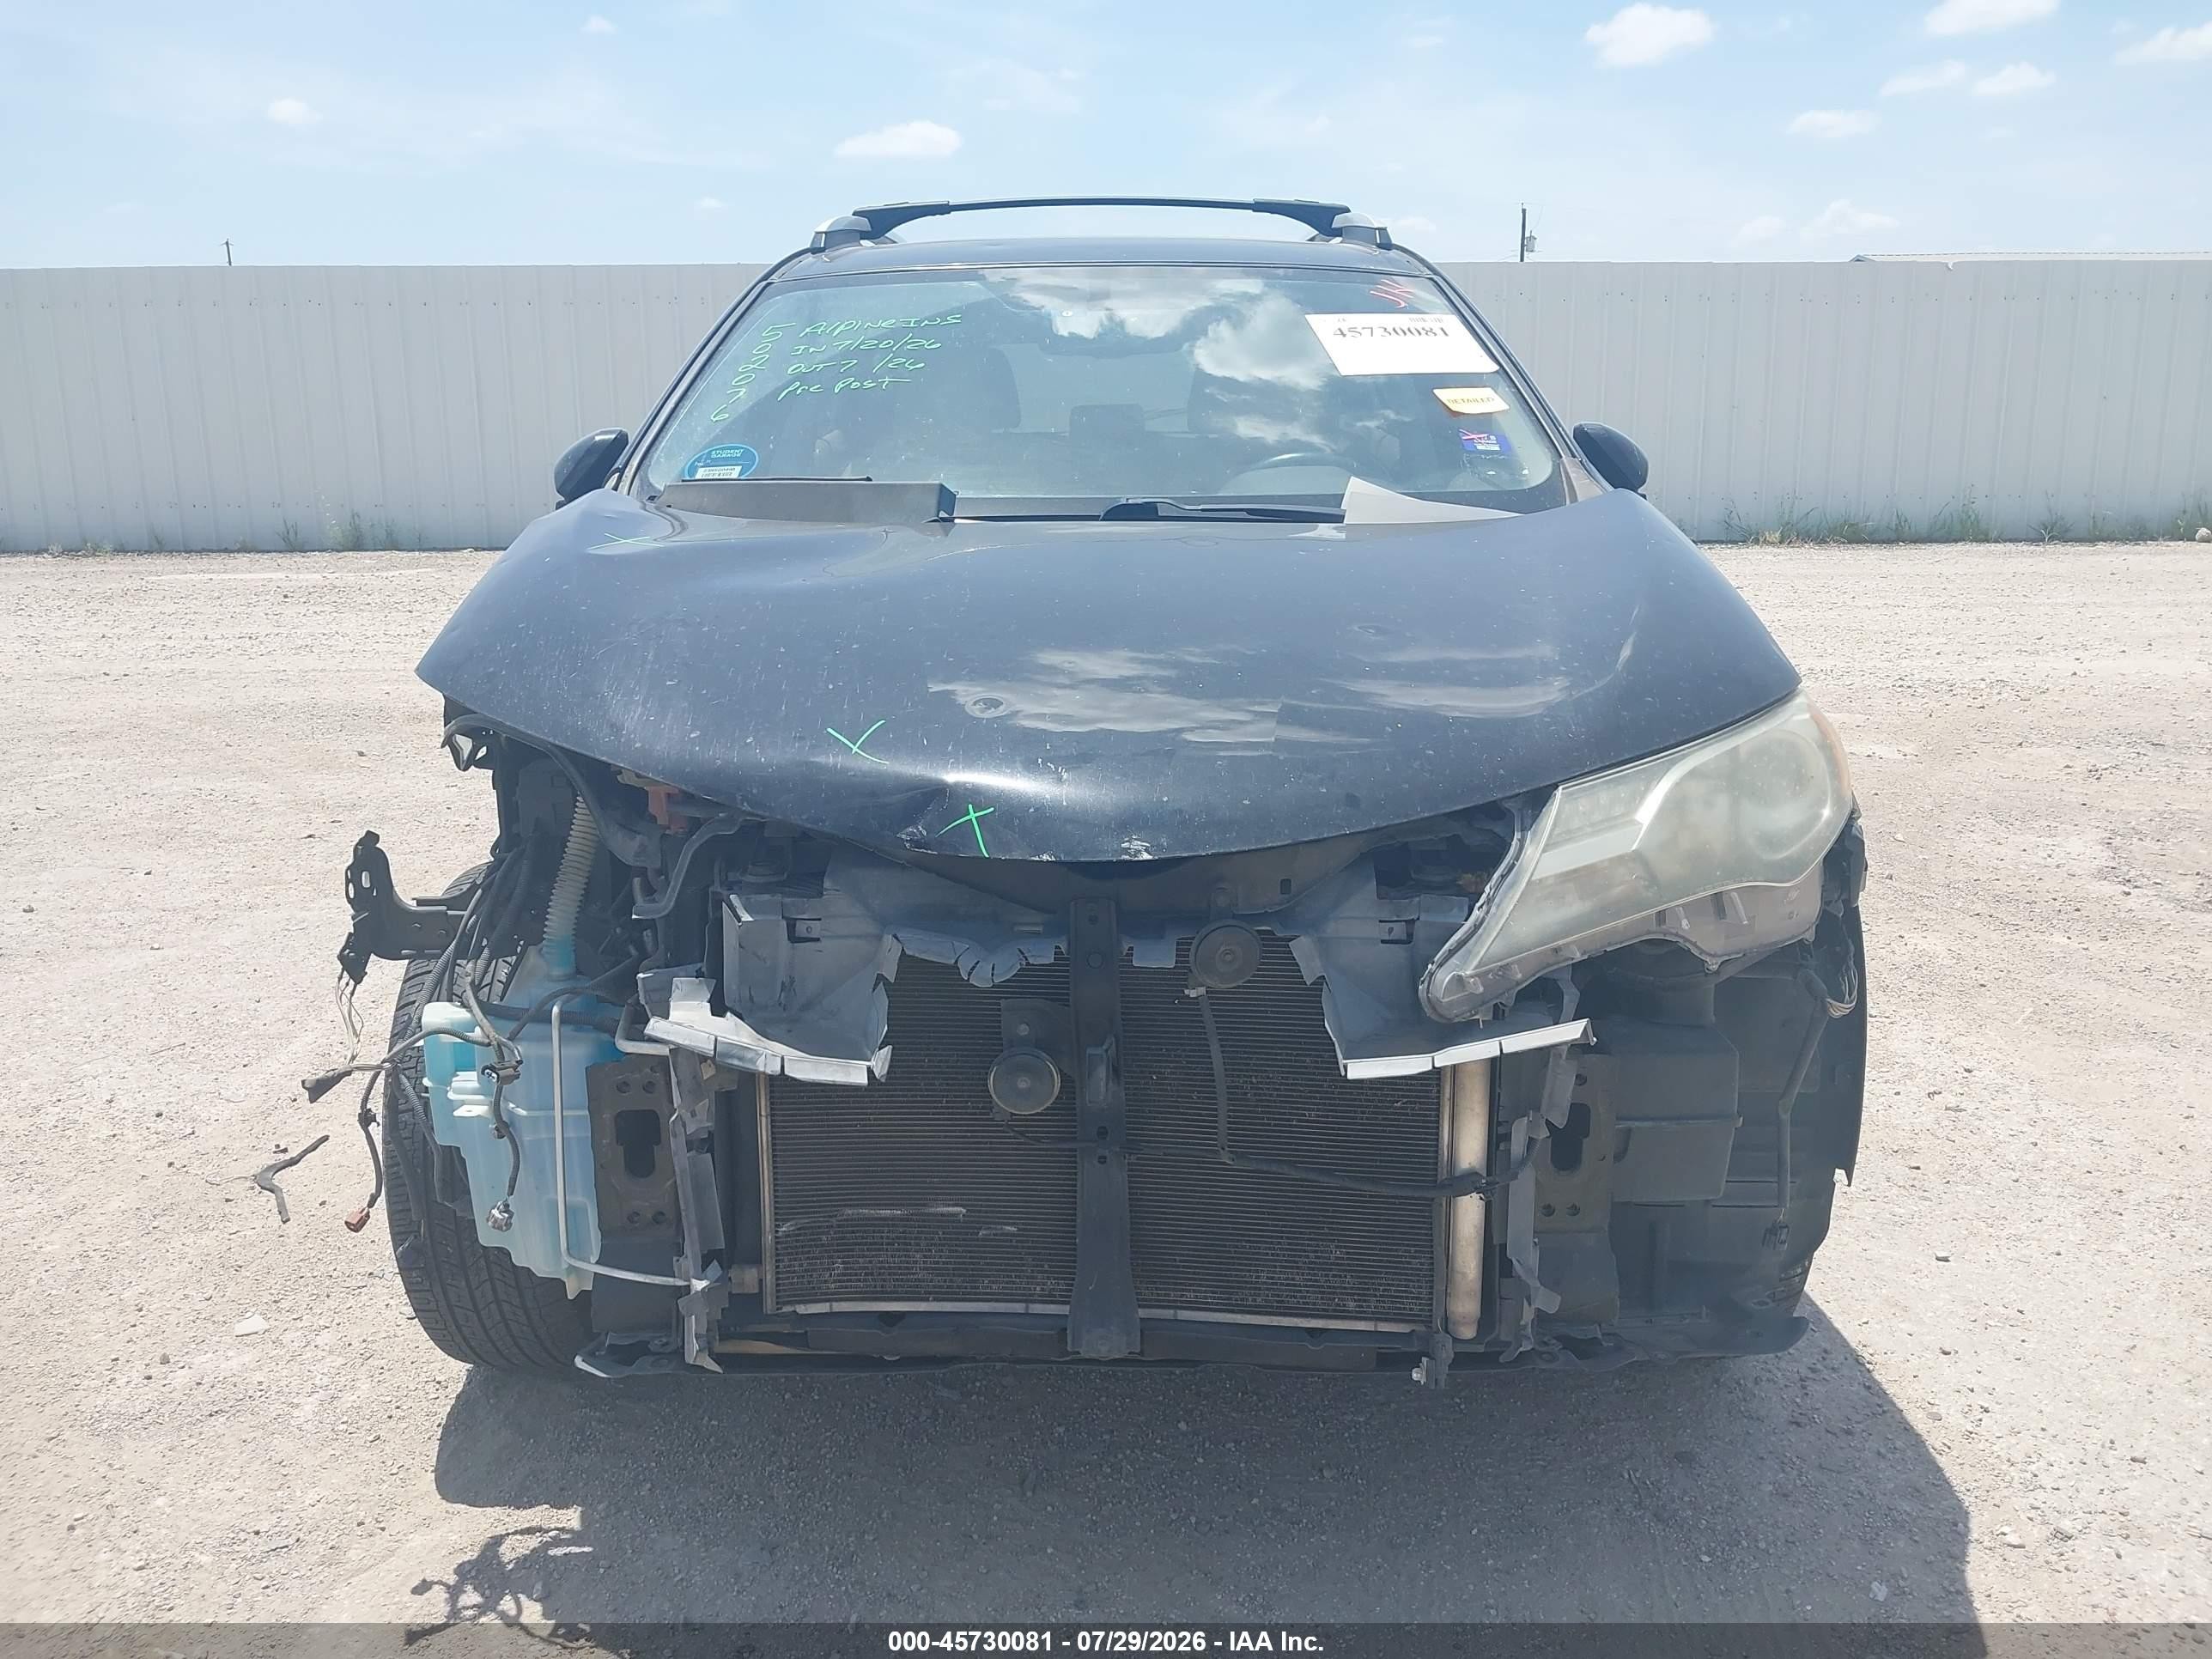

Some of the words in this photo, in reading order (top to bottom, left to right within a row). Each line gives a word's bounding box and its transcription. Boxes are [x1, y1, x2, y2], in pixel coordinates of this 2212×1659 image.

[1333, 325, 1450, 338] 45730081
[790, 344, 827, 356] IN
[833, 332, 943, 352] 7/20/26
